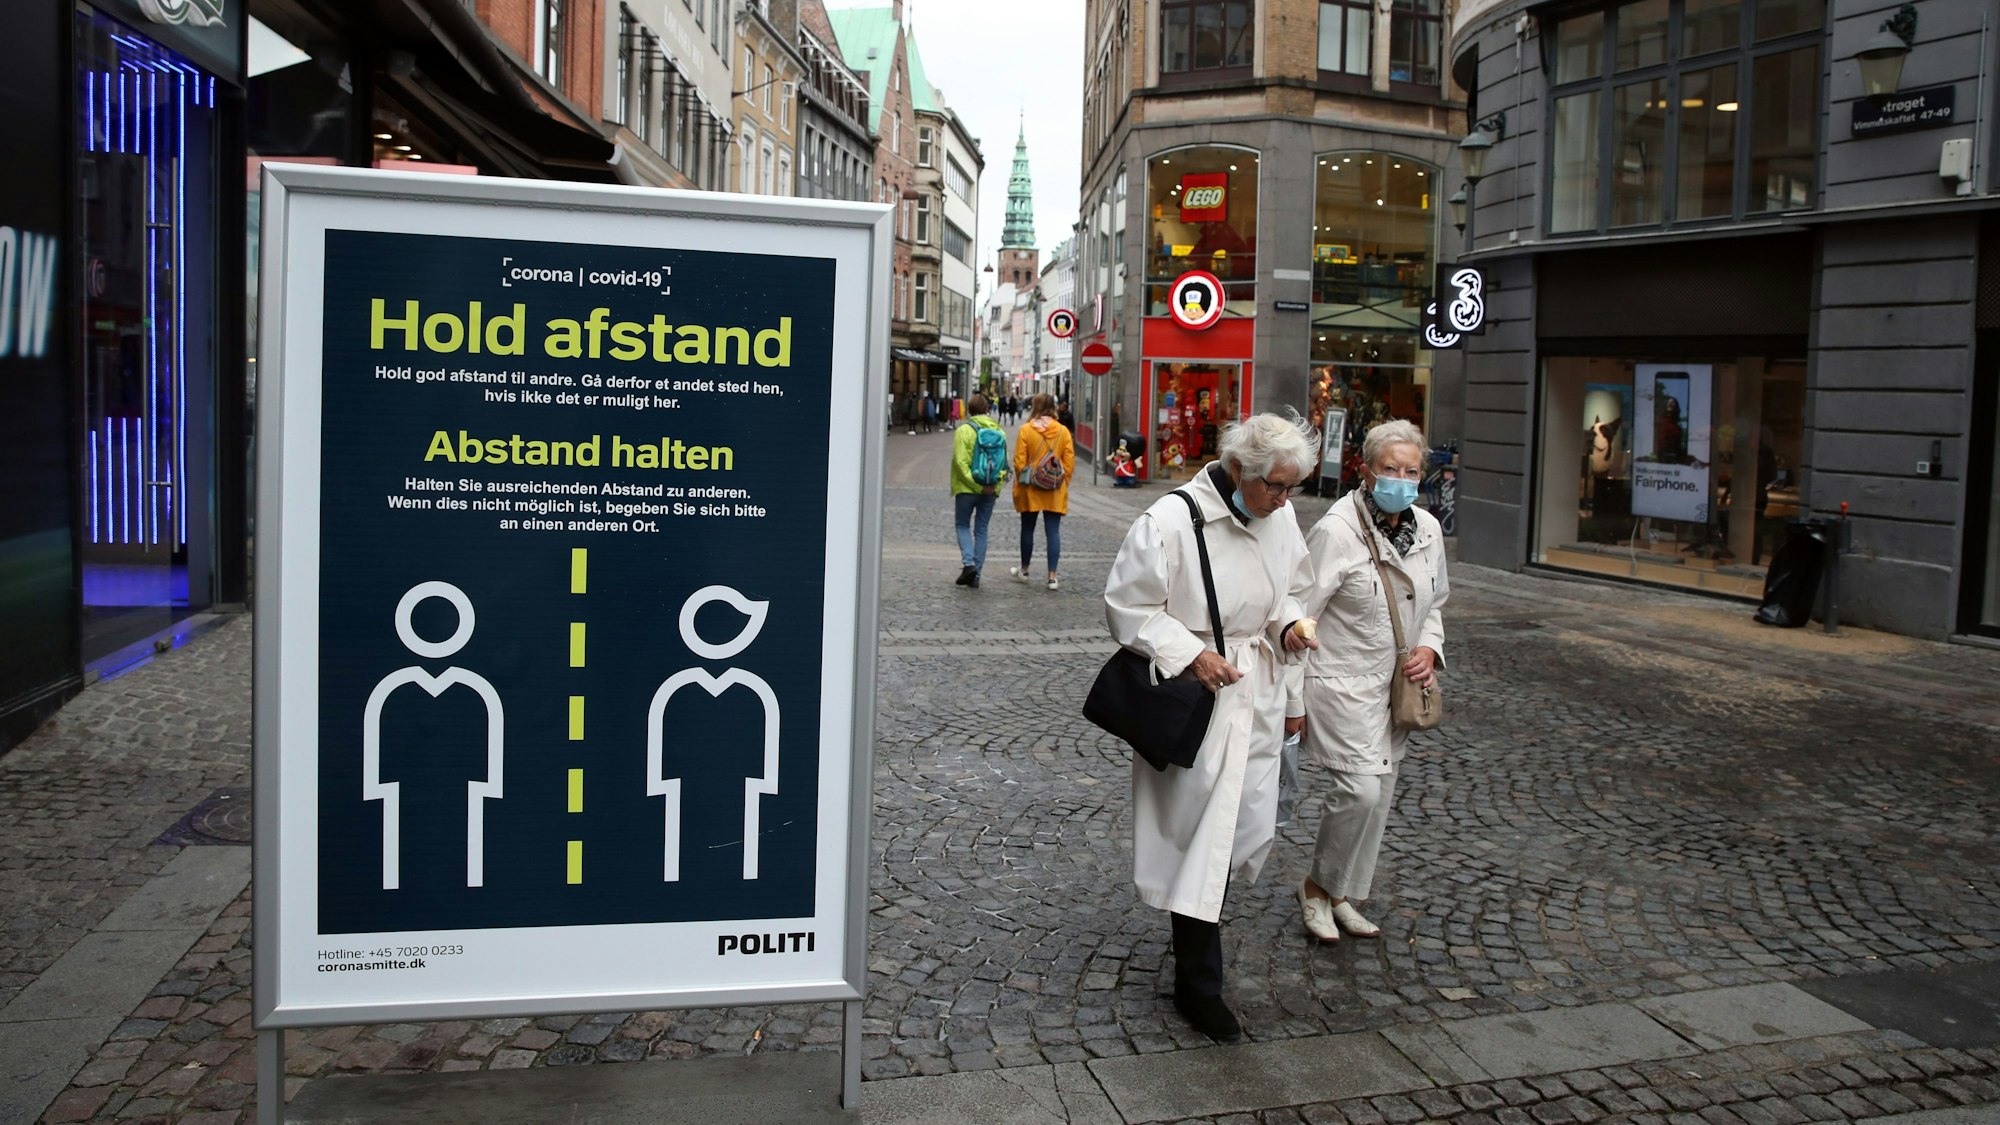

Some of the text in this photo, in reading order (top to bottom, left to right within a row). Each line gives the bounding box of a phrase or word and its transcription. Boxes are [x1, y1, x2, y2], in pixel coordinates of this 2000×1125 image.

[1882, 96, 1925, 112] trøget
[1920, 107, 1950, 119] 47-49
[1184, 188, 1223, 207] LEGO
[509, 267, 574, 283] corona
[588, 269, 663, 288] covid-19
[1449, 268, 1484, 331] 3
[370, 298, 792, 367] Hold afstand
[375, 365, 783, 397] Hold god afstand til andre. Gå derfor et andet sted hen,
[484, 388, 680, 410] hvis ikke det er muligt her.
[423, 430, 733, 470] Abstand halten
[405, 477, 751, 499] Halten Sie ausreichenden Abstand zu anderen.
[1635, 475, 1699, 492] Fairphone.
[387, 495, 766, 517] Wenn dies nicht möglich ist, begeben Sie sich bitte
[499, 517, 659, 532] an einen anderen Ort.
[317, 944, 464, 959] Hotline: +45 7020 0233
[717, 931, 815, 956] POLITI
[317, 958, 426, 972] coronasmitte.dk
